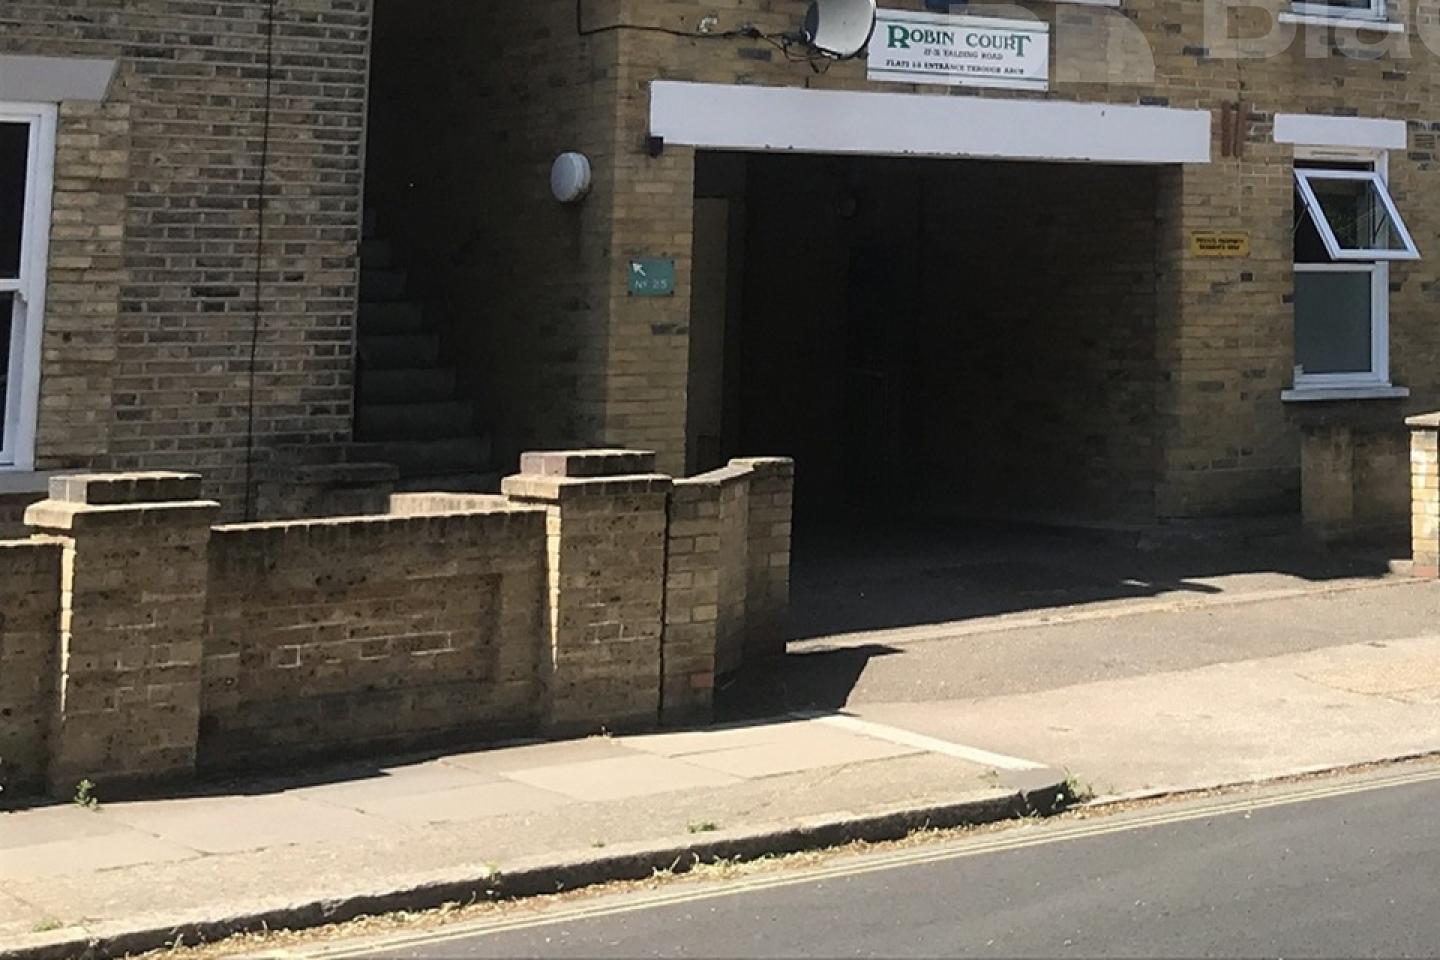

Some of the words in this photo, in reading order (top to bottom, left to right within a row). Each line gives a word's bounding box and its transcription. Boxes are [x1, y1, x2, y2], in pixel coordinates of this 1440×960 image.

[887, 25, 955, 49] ROBIN
[965, 33, 1032, 57] COURT
[924, 61, 964, 72] ENTRANCE
